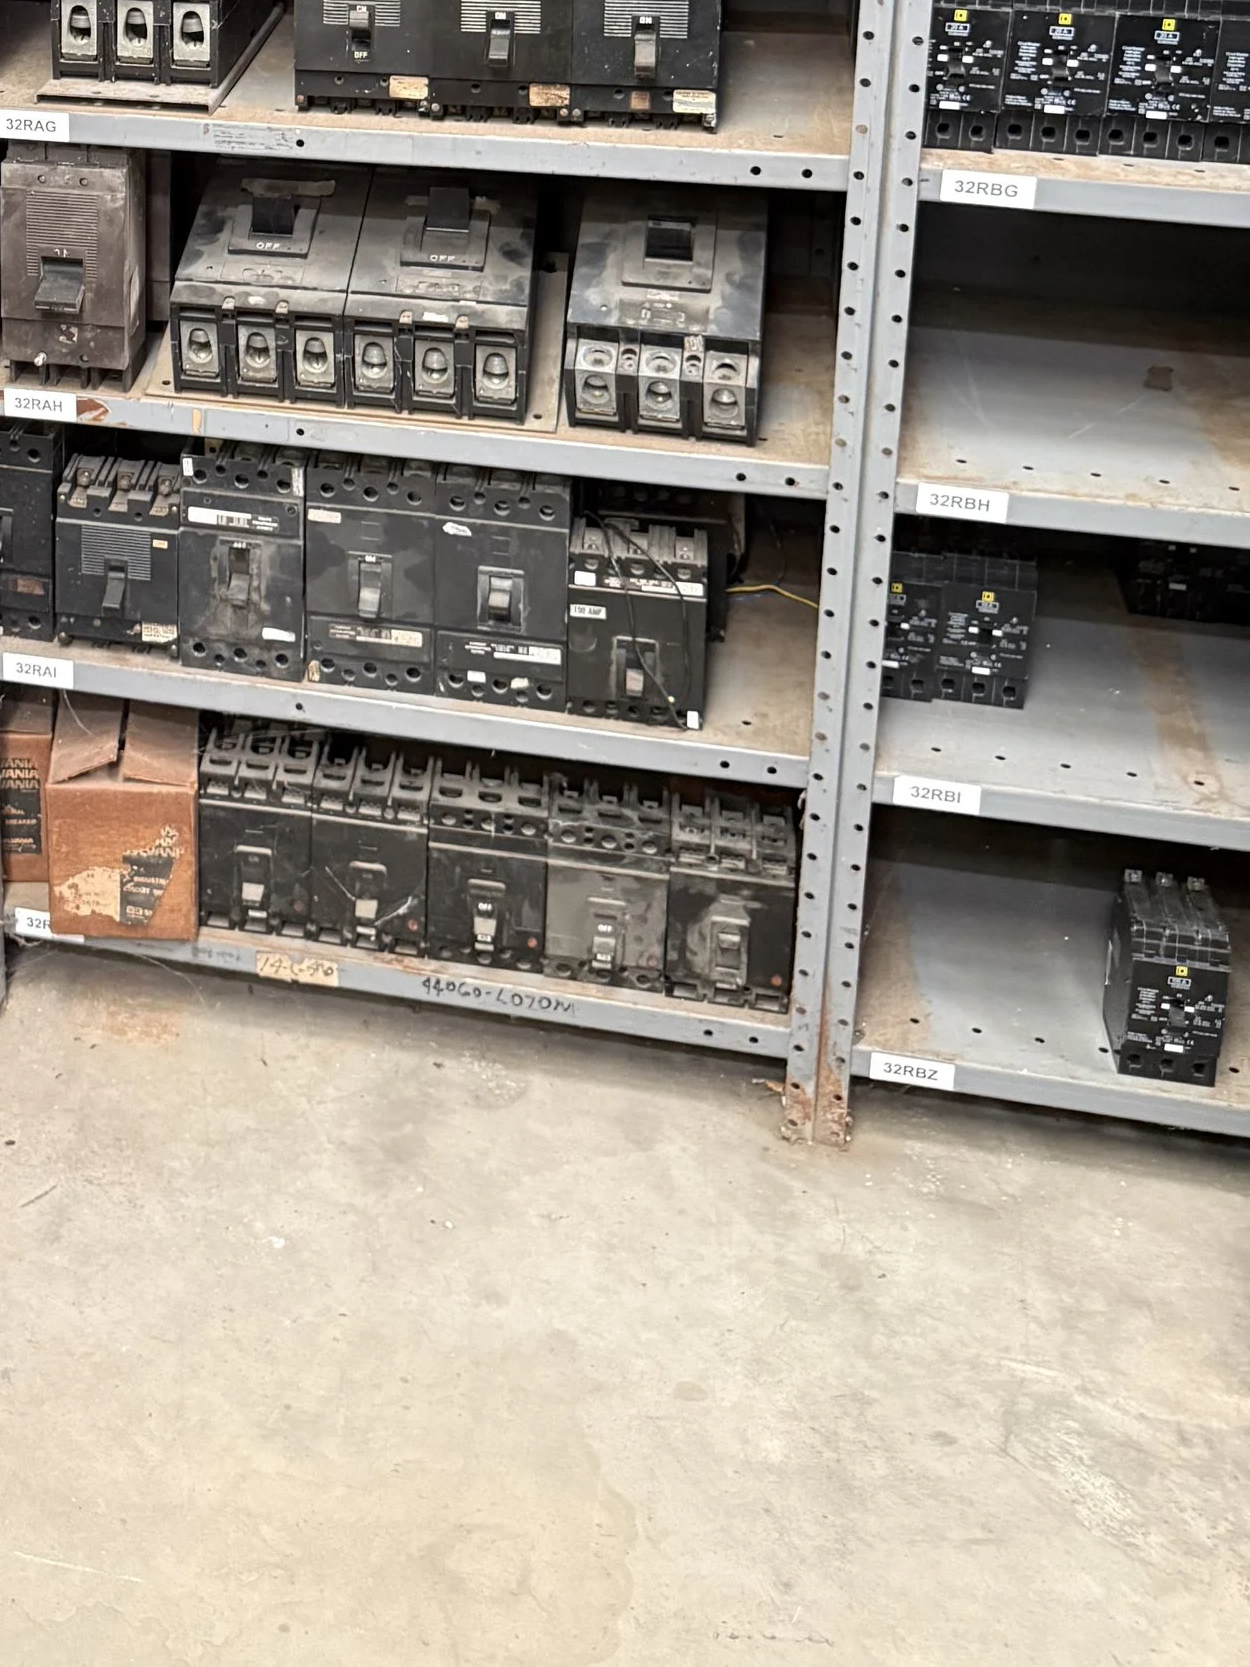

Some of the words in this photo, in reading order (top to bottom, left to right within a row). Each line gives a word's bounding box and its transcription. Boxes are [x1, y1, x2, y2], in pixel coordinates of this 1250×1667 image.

[495, 12, 506, 20] ON
[639, 16, 652, 24] ON
[354, 51, 368, 59] OFF
[7, 119, 56, 132] 32RAG
[955, 181, 1017, 197] 32RBG
[256, 241, 280, 250] OFF
[430, 254, 456, 263] OFF
[15, 398, 62, 411] 32RAH
[931, 494, 990, 511] 32RBH
[588, 607, 602, 616] AMP
[16, 662, 56, 678] 32RAI
[911, 786, 960, 803] 32RBI
[883, 1064, 937, 1080] 32RBZ
